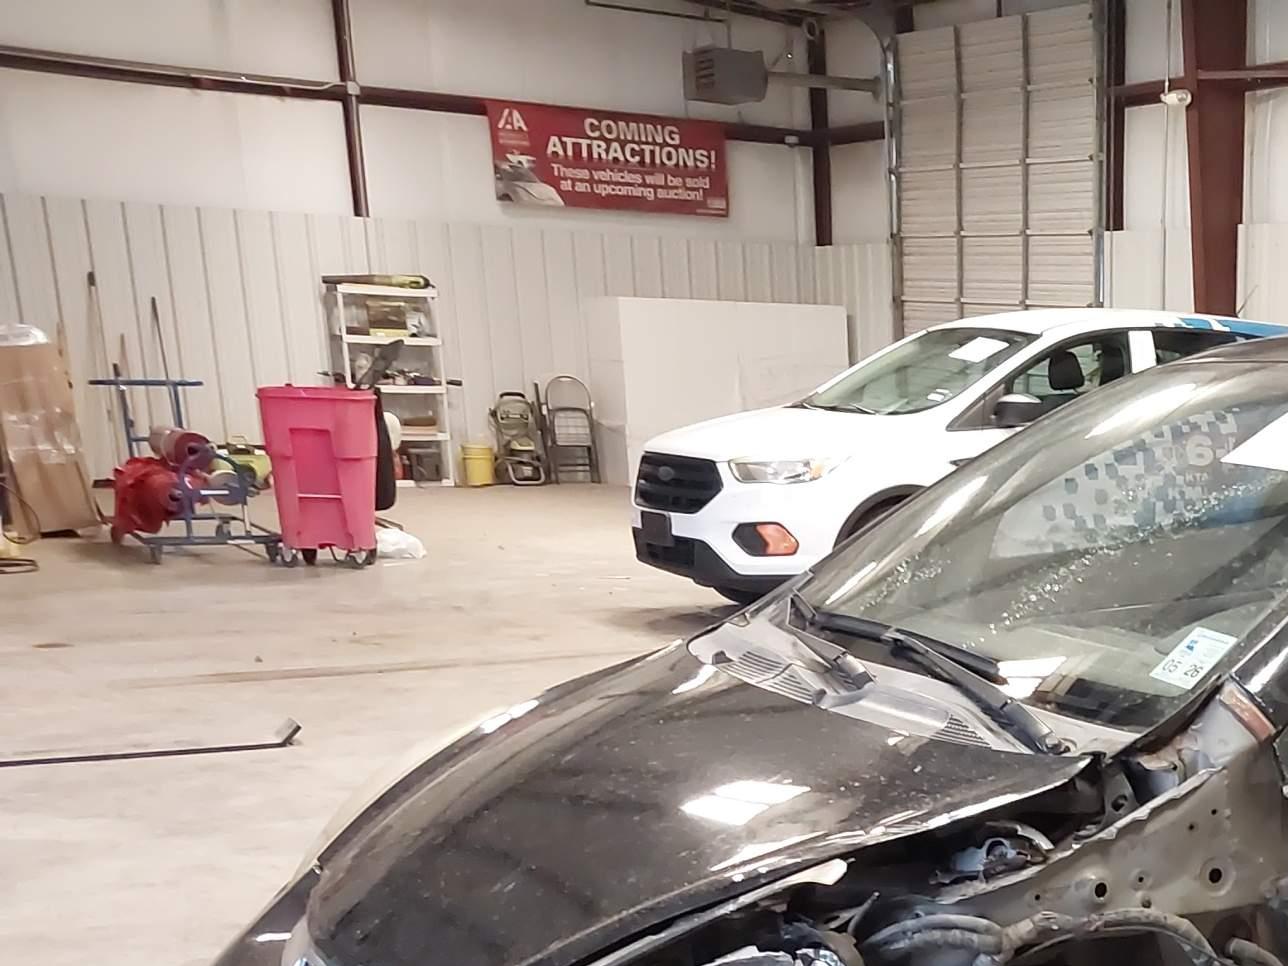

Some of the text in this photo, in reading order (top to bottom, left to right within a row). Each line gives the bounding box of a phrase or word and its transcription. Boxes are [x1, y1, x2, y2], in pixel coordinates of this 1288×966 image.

[584, 118, 680, 145] COMING
[546, 136, 716, 169] ATTRACTIONS!
[551, 163, 710, 189] These vehicles will be sold
[560, 179, 704, 201] at an upcoming auction!
[1184, 665, 1203, 678] 26
